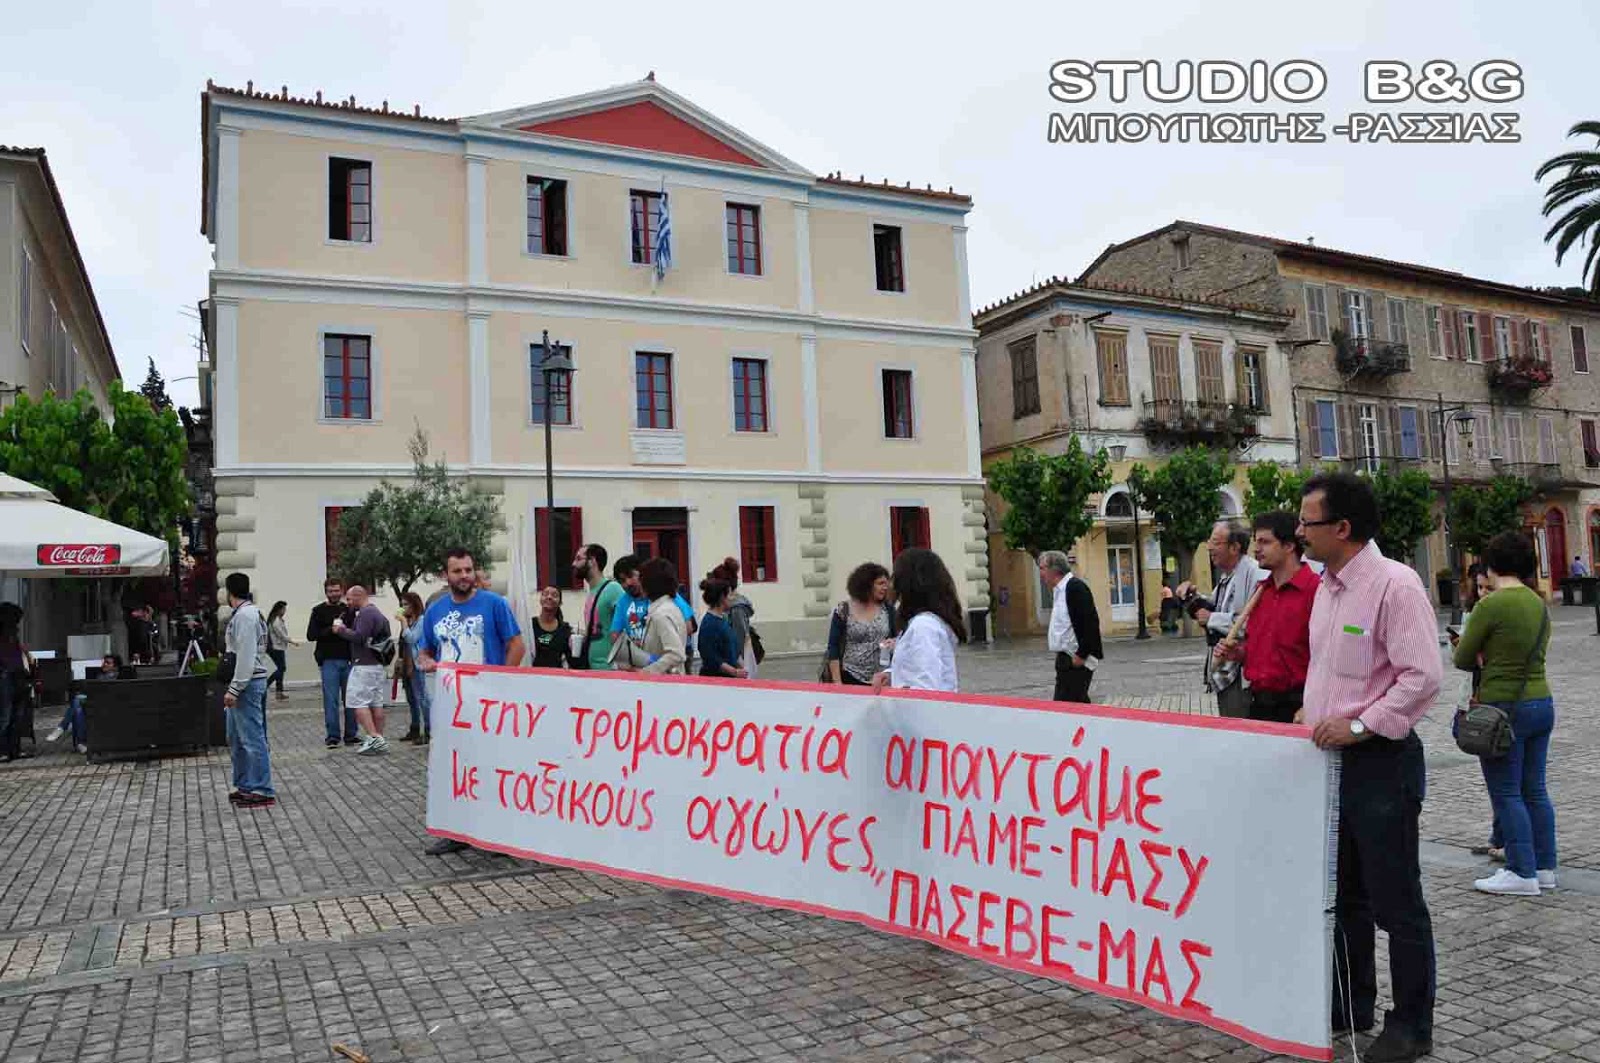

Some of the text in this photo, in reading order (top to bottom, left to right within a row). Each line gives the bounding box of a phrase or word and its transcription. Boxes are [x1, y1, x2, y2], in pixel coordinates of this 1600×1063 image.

[50, 545, 106, 564] Coca-Cola
[495, 760, 656, 831] ταξικούς
[570, 700, 854, 779] τρομοκρατία
[886, 727, 1164, 831] απαντάμε
[923, 801, 1209, 919] ΠΑΜΕ-ΠΑΣΥ
[889, 869, 1214, 1017] ΠΑΣΕΒΕ-ΜΑΣ
